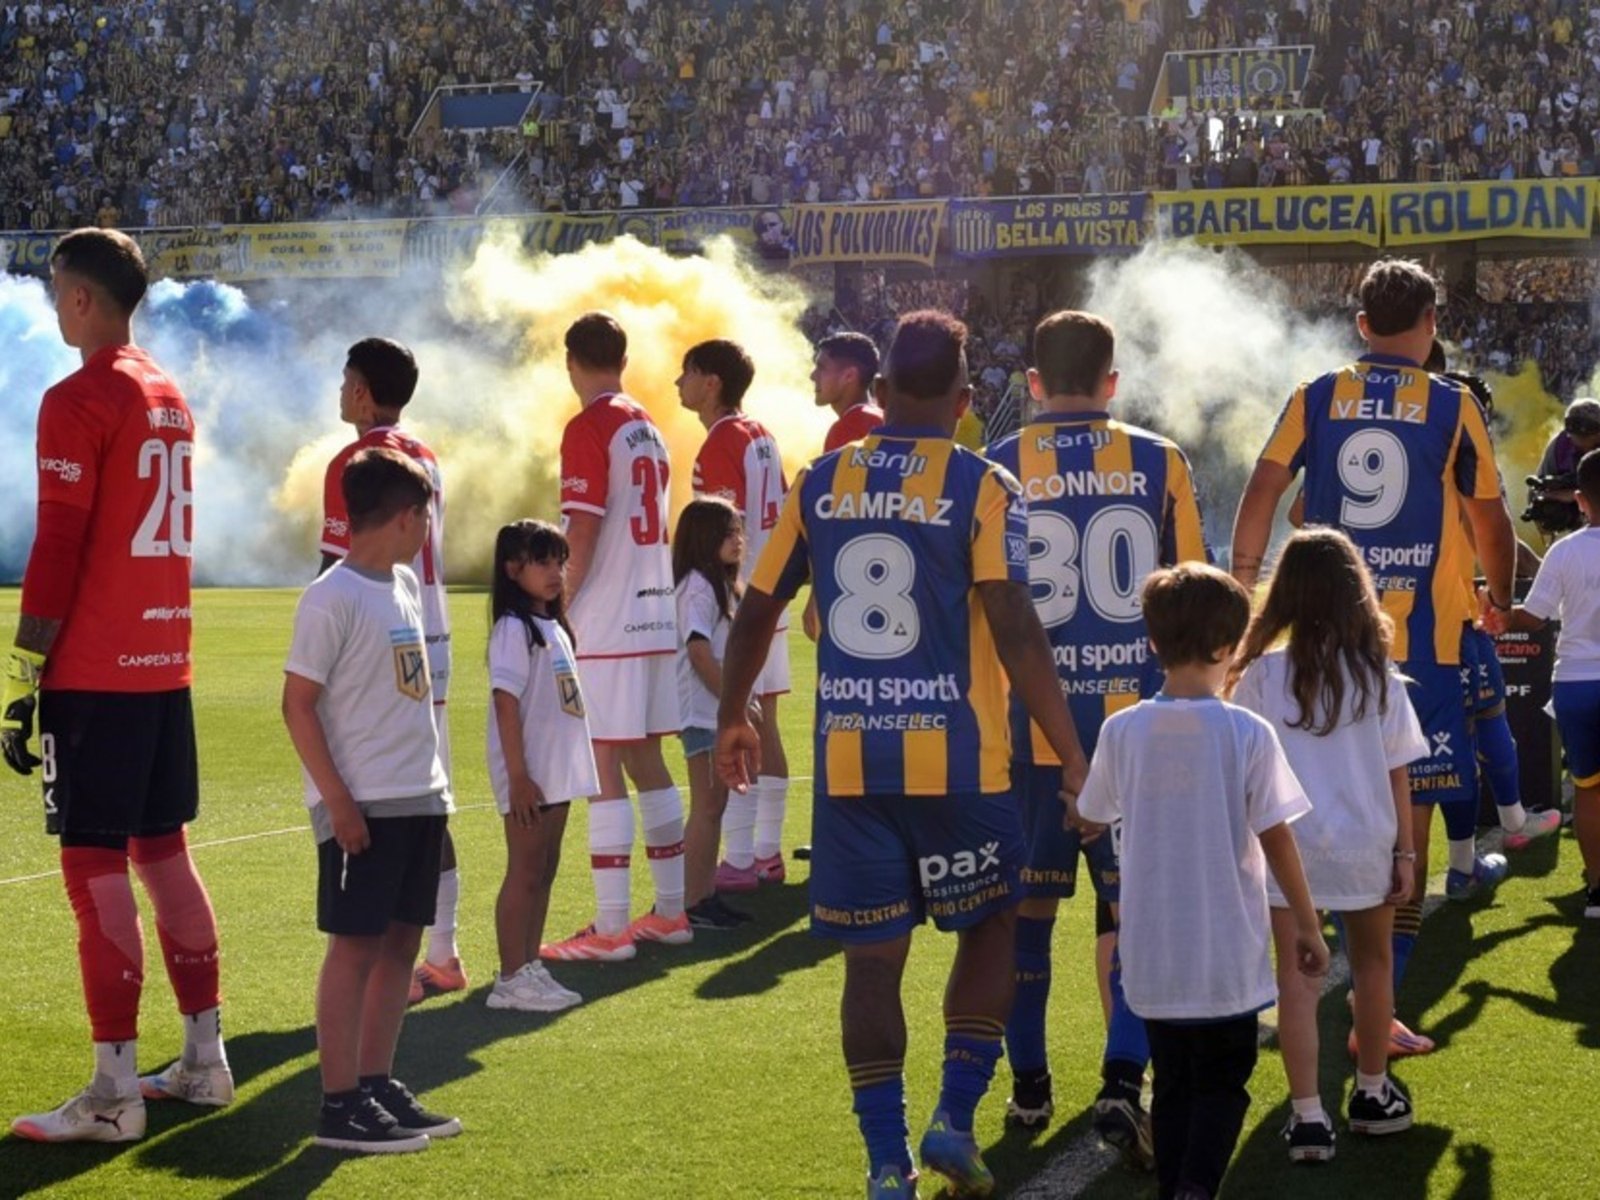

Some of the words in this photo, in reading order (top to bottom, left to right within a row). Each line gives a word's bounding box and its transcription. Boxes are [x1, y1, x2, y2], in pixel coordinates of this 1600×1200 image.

[1195, 84, 1241, 98] ROSAS
[1203, 69, 1231, 82] LAS
[1015, 202, 1046, 220] LOS
[1052, 200, 1102, 218] PIBES
[1108, 199, 1130, 215] DE
[1172, 195, 1377, 238] BARLUCEA
[1390, 185, 1587, 235] ROLDAN
[794, 209, 825, 257] LOS
[830, 207, 938, 257] POLVORINES
[996, 221, 1069, 250] BELLA
[1074, 219, 1140, 246] VISTA
[270, 245, 304, 254] COSA
[1336, 399, 1425, 424] VELIZ
[1336, 427, 1410, 530] 9
[131, 438, 193, 557] 28
[814, 491, 954, 527] CAMPAZ
[1027, 504, 1159, 630] 30
[1368, 542, 1434, 571] sportif
[828, 533, 921, 660] 8
[1081, 638, 1147, 671] sporti
[1496, 643, 1541, 657] etano
[1060, 677, 1141, 695] ANSELEC
[1505, 685, 1532, 696] PF
[919, 841, 1001, 888] pax
[922, 873, 999, 898] assistance
